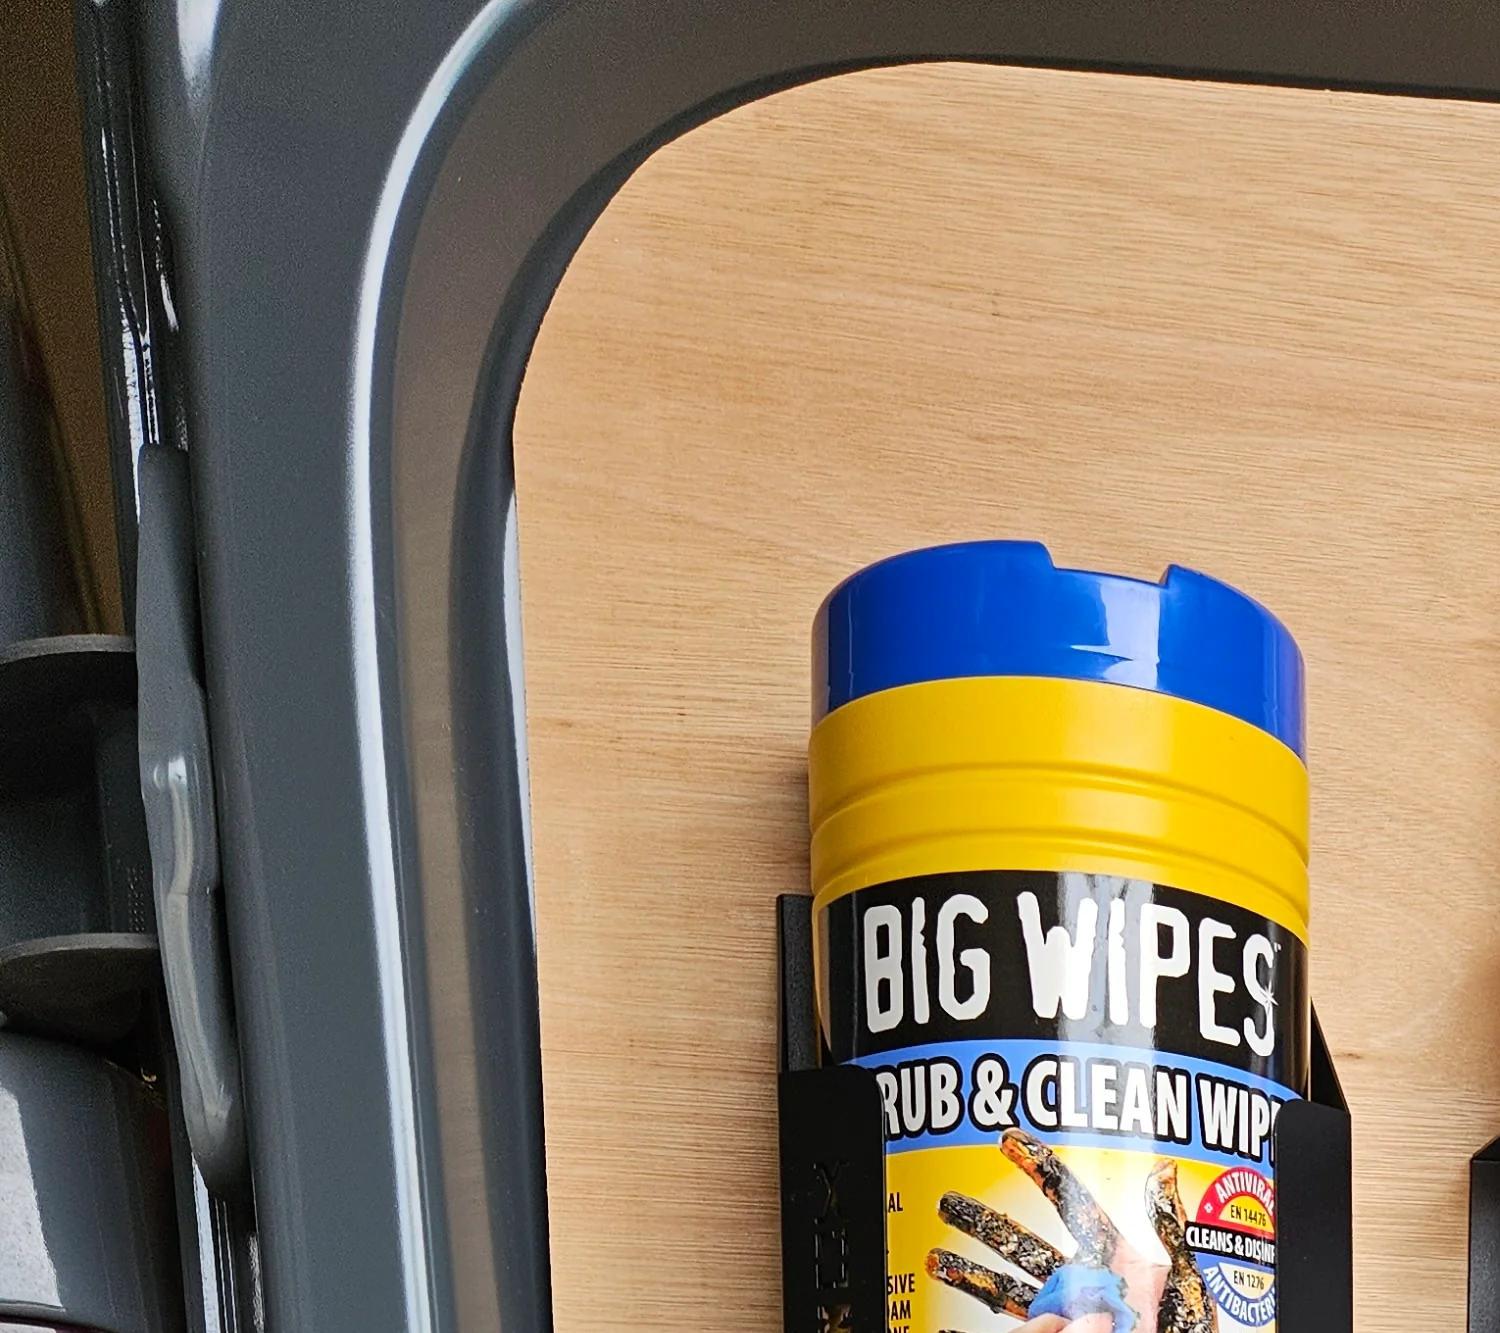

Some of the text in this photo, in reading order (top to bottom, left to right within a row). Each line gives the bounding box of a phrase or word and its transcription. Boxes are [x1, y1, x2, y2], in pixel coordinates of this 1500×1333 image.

[863, 891, 1278, 1057] BIG WIPES
[876, 1058, 1280, 1162] RUB & CLEAN WIP
[888, 1192, 903, 1213] AL
[1215, 1171, 1276, 1217] ANTIVIRAL
[1231, 1205, 1267, 1227] EN 14476
[1186, 1226, 1276, 1264] CLEANS & DISINF
[887, 1273, 915, 1295] SIVE
[1233, 1271, 1265, 1290] EN 1276
[888, 1300, 911, 1320] AM
[1203, 1266, 1276, 1326] ANTIBACTERI
